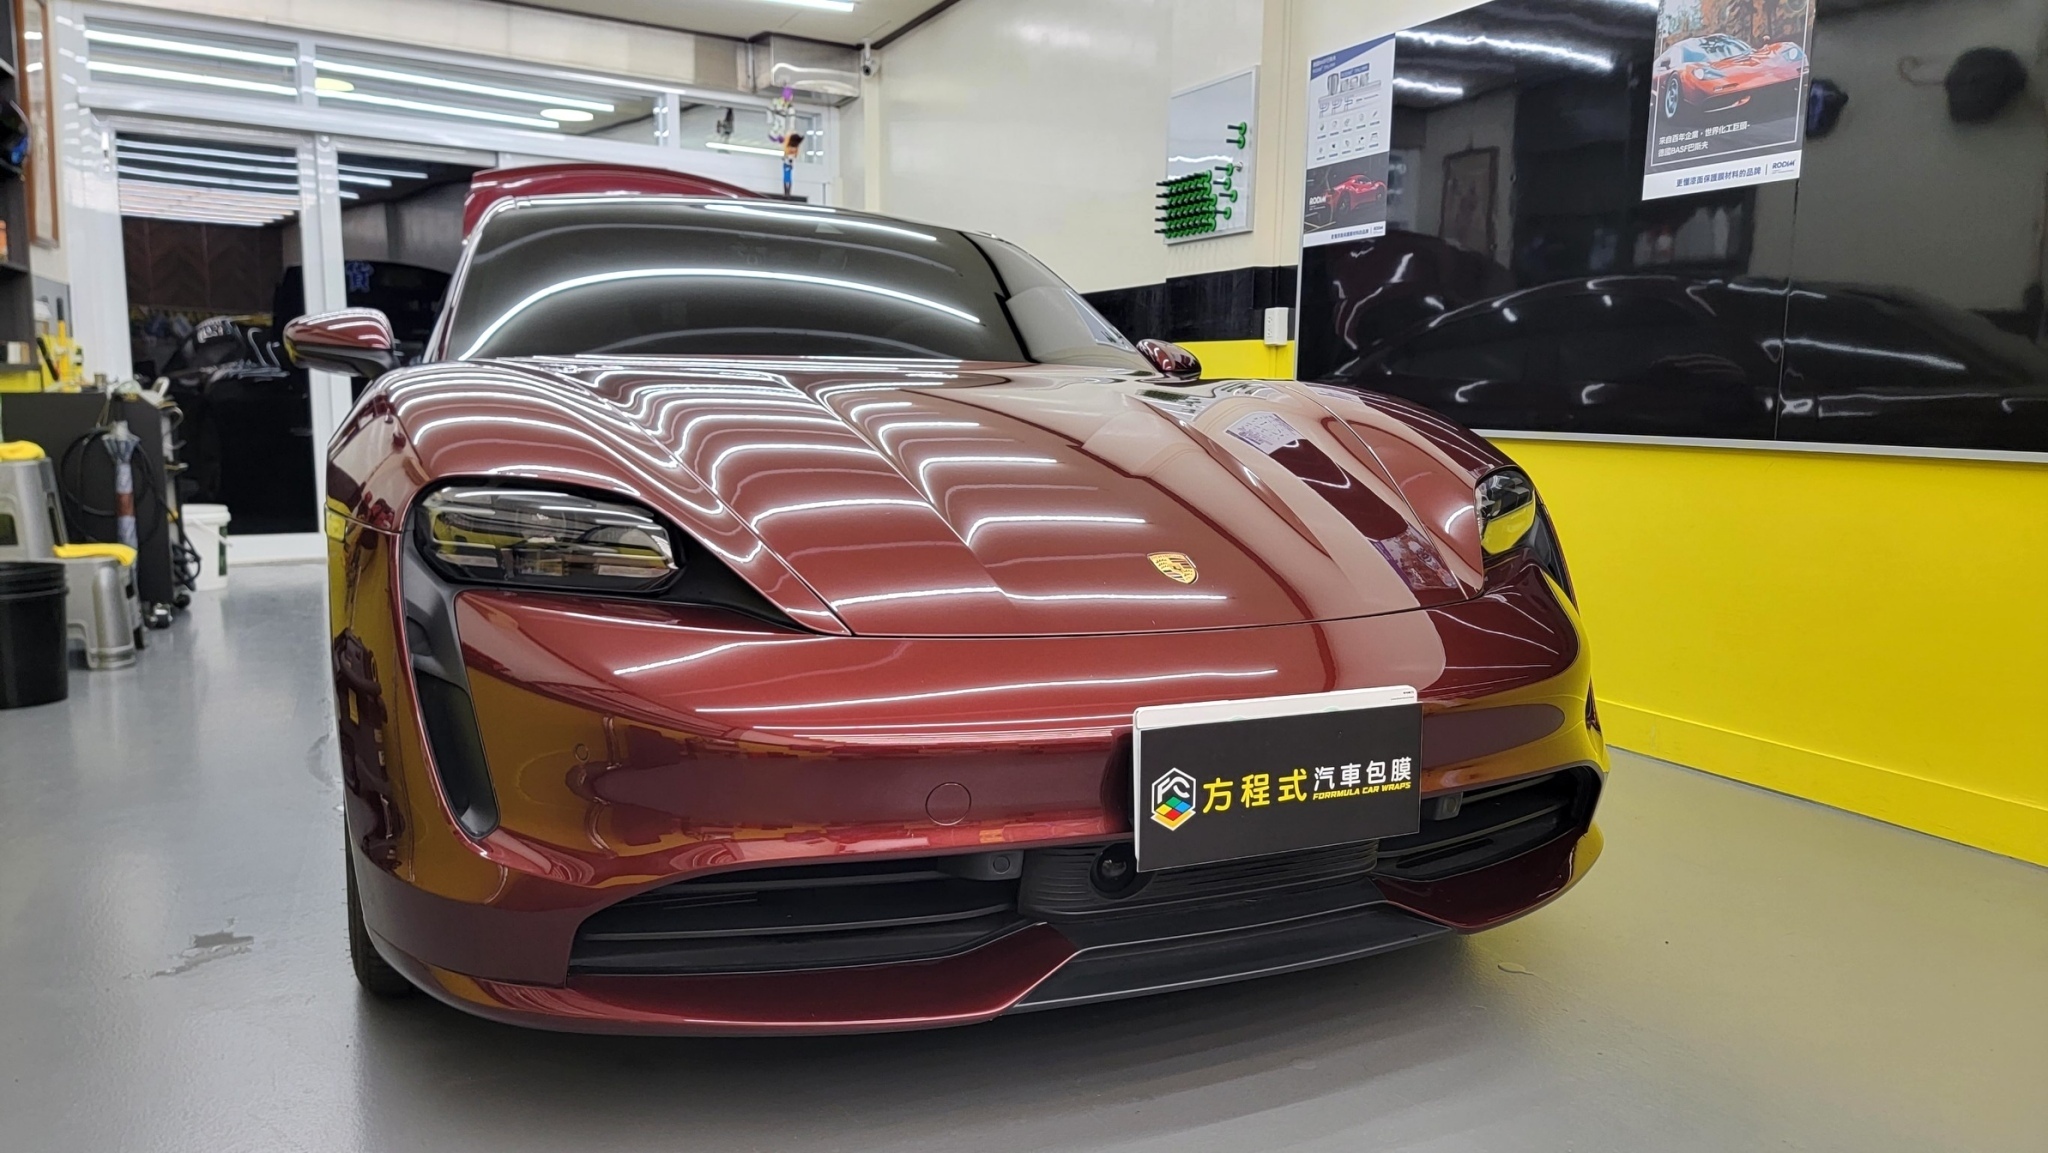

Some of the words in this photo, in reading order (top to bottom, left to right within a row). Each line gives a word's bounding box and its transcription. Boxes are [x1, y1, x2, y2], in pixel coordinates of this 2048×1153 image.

[1202, 768, 1308, 814] 方程式
[1313, 756, 1412, 792] 汽車包膜
[1312, 787, 1361, 801] FORRMULA
[1362, 785, 1380, 794] CAR
[1381, 781, 1412, 792] WRAPS
